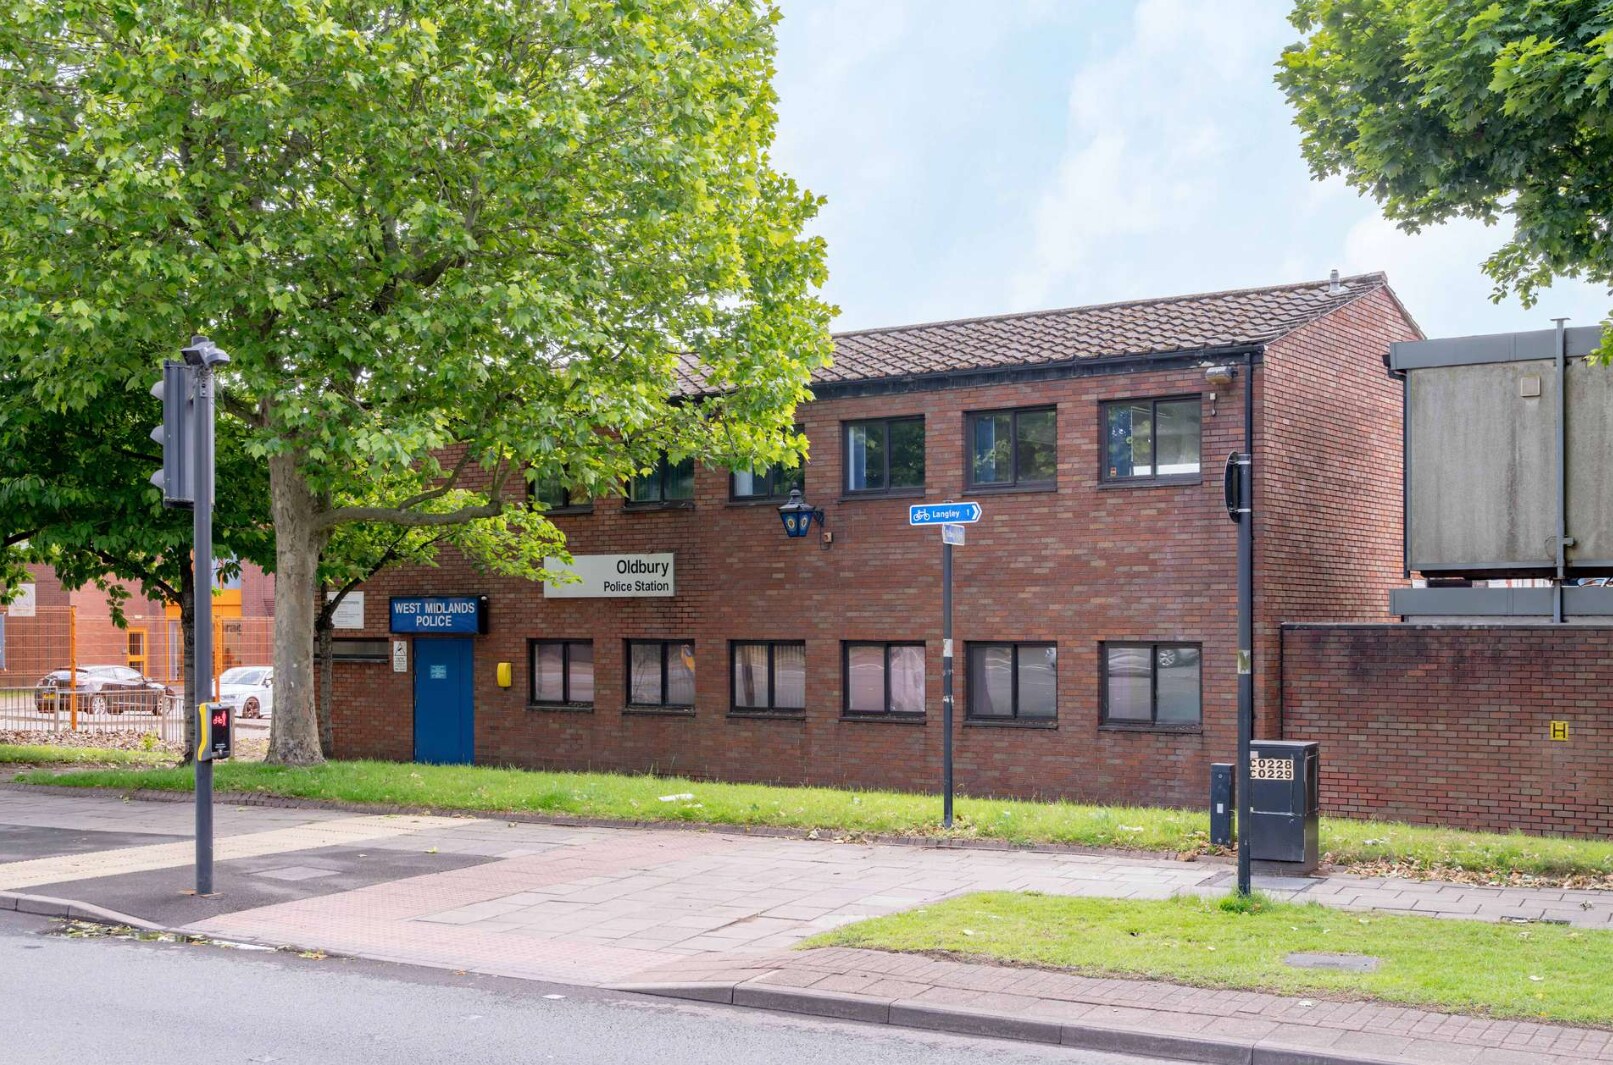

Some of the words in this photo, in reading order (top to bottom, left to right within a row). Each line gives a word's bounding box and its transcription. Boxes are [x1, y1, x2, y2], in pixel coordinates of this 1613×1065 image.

[932, 509, 960, 518] Langley
[616, 559, 669, 577] Oldbury
[603, 580, 632, 592] Police
[634, 580, 669, 592] Station
[394, 602, 421, 614] WEST
[424, 602, 475, 614] MIDLANDS
[416, 615, 452, 627] POLICE
[1552, 722, 1566, 738] H
